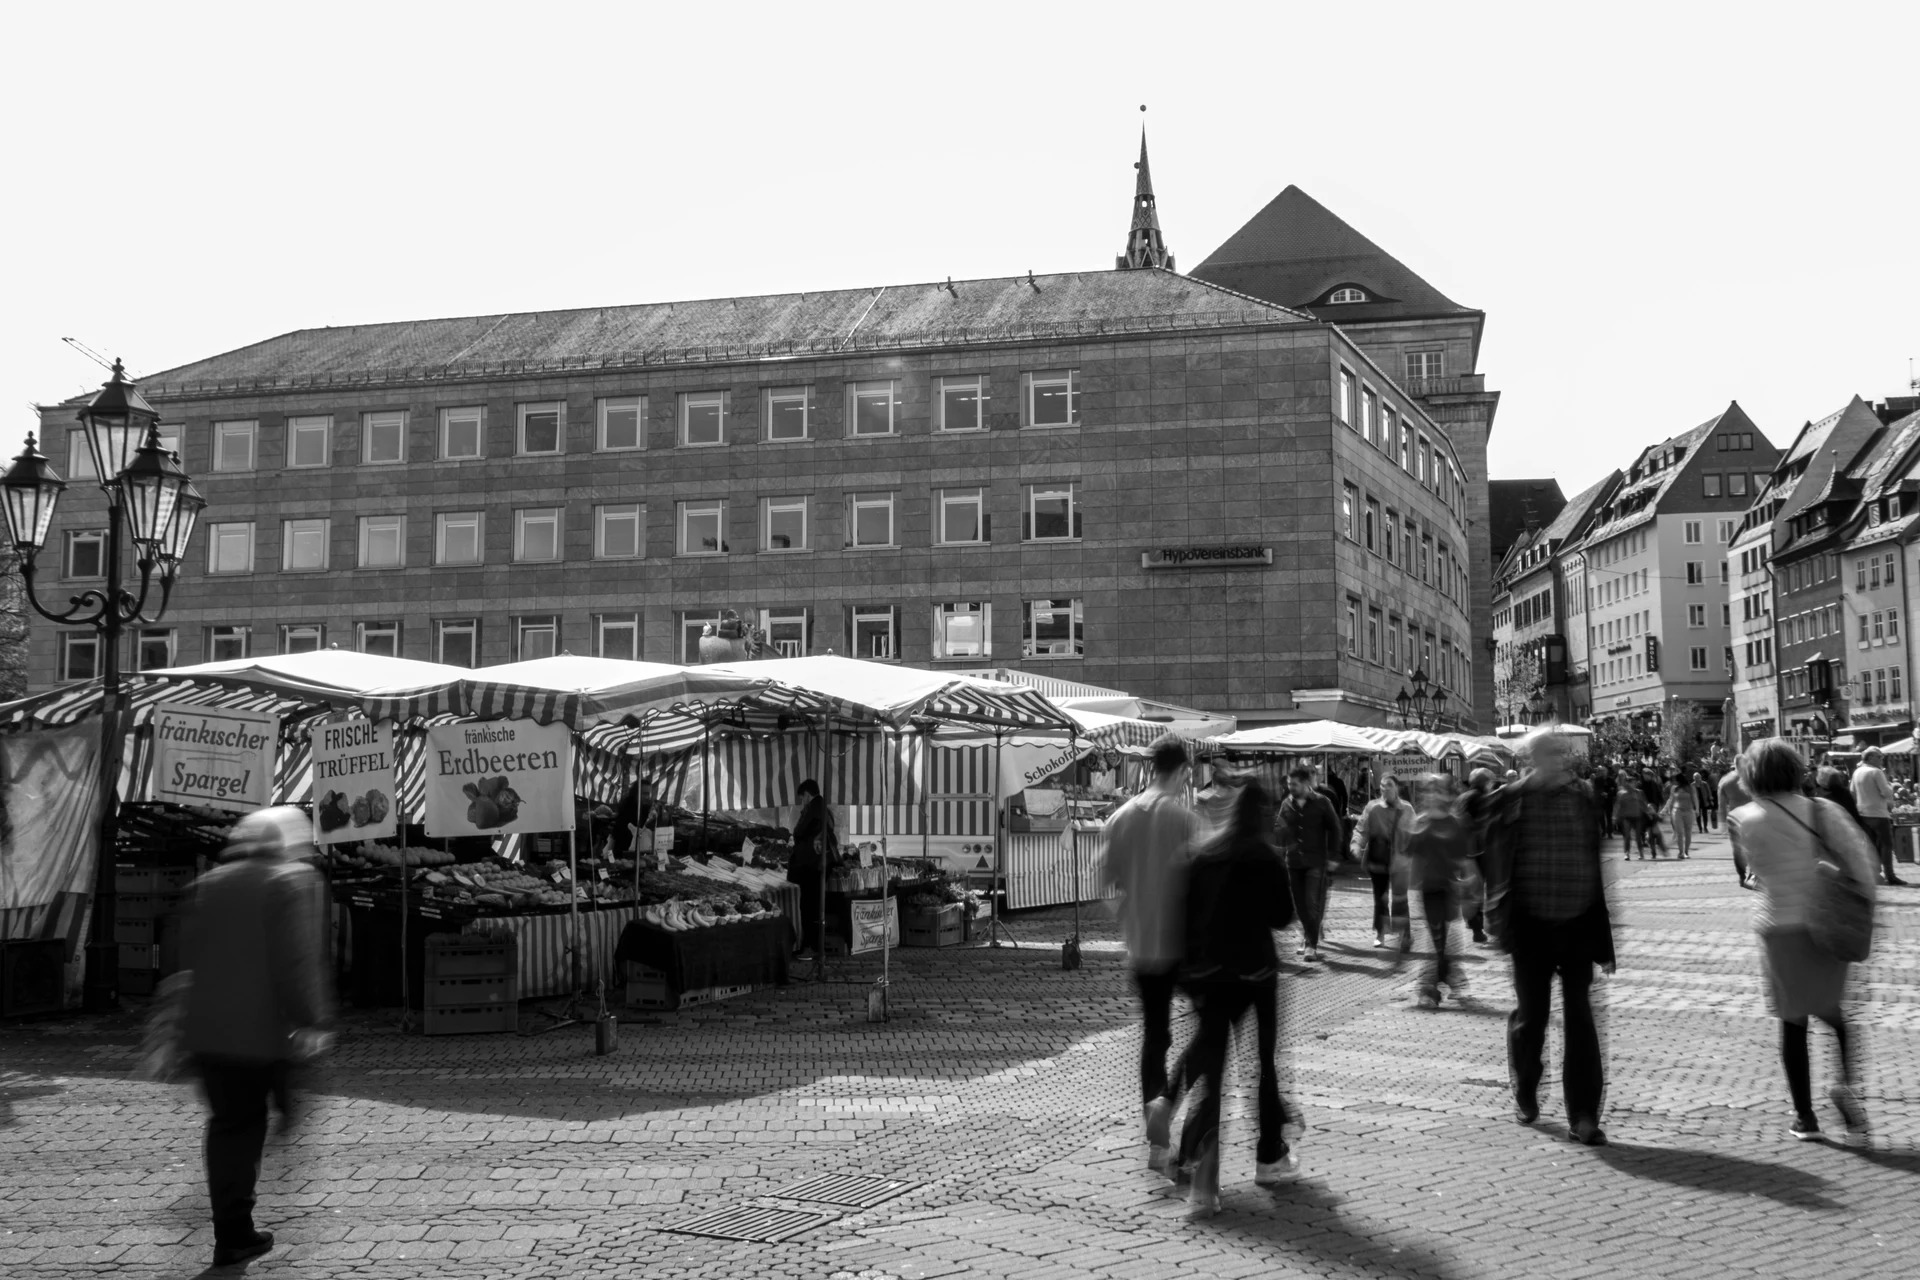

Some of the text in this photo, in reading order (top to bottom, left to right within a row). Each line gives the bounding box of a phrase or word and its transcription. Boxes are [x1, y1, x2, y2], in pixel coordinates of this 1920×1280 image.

[1162, 546, 1265, 564] HypoVereinsbank
[159, 715, 269, 750] fränkischer
[325, 723, 378, 750] FRISCHE
[465, 726, 516, 744] fränkische
[317, 752, 389, 779] TRÜFFEL
[438, 748, 558, 776] Erdbeeren
[1392, 766, 1426, 776] Spargel
[171, 762, 251, 797] Spargel
[860, 927, 892, 948] Spargl
